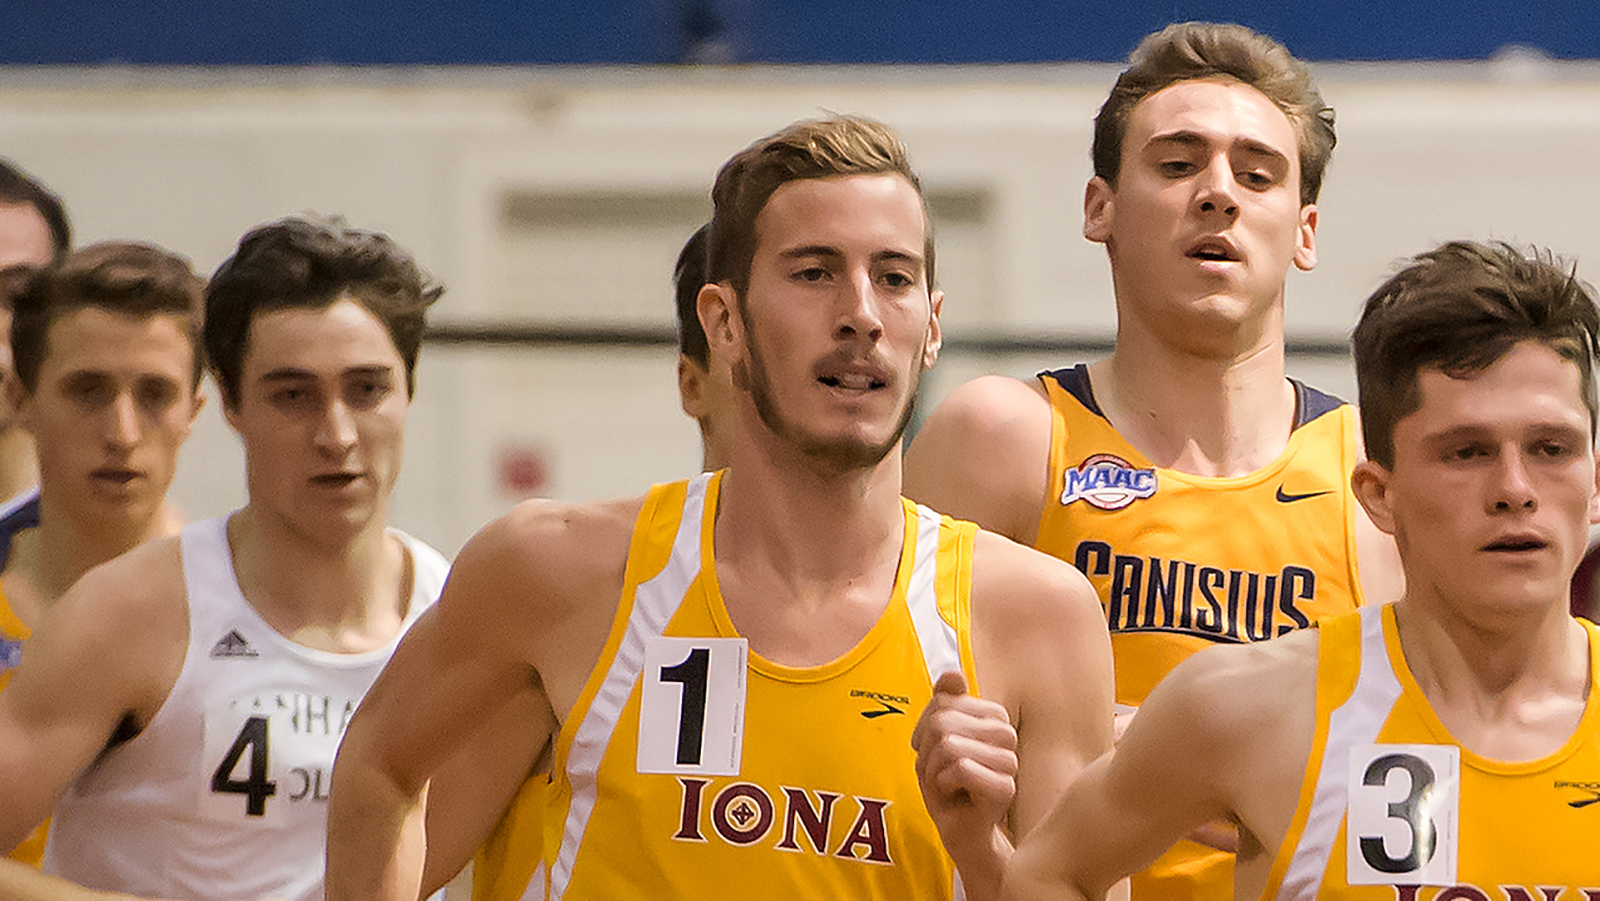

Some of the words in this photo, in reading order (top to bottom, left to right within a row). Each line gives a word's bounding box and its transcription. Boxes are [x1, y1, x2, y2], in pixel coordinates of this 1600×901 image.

[1063, 466, 1155, 499] MAAC
[1073, 541, 1316, 643] CANISIUS
[659, 648, 710, 765] 1
[211, 716, 276, 816] 4
[1359, 753, 1437, 874] 3
[671, 775, 894, 866] IONA
